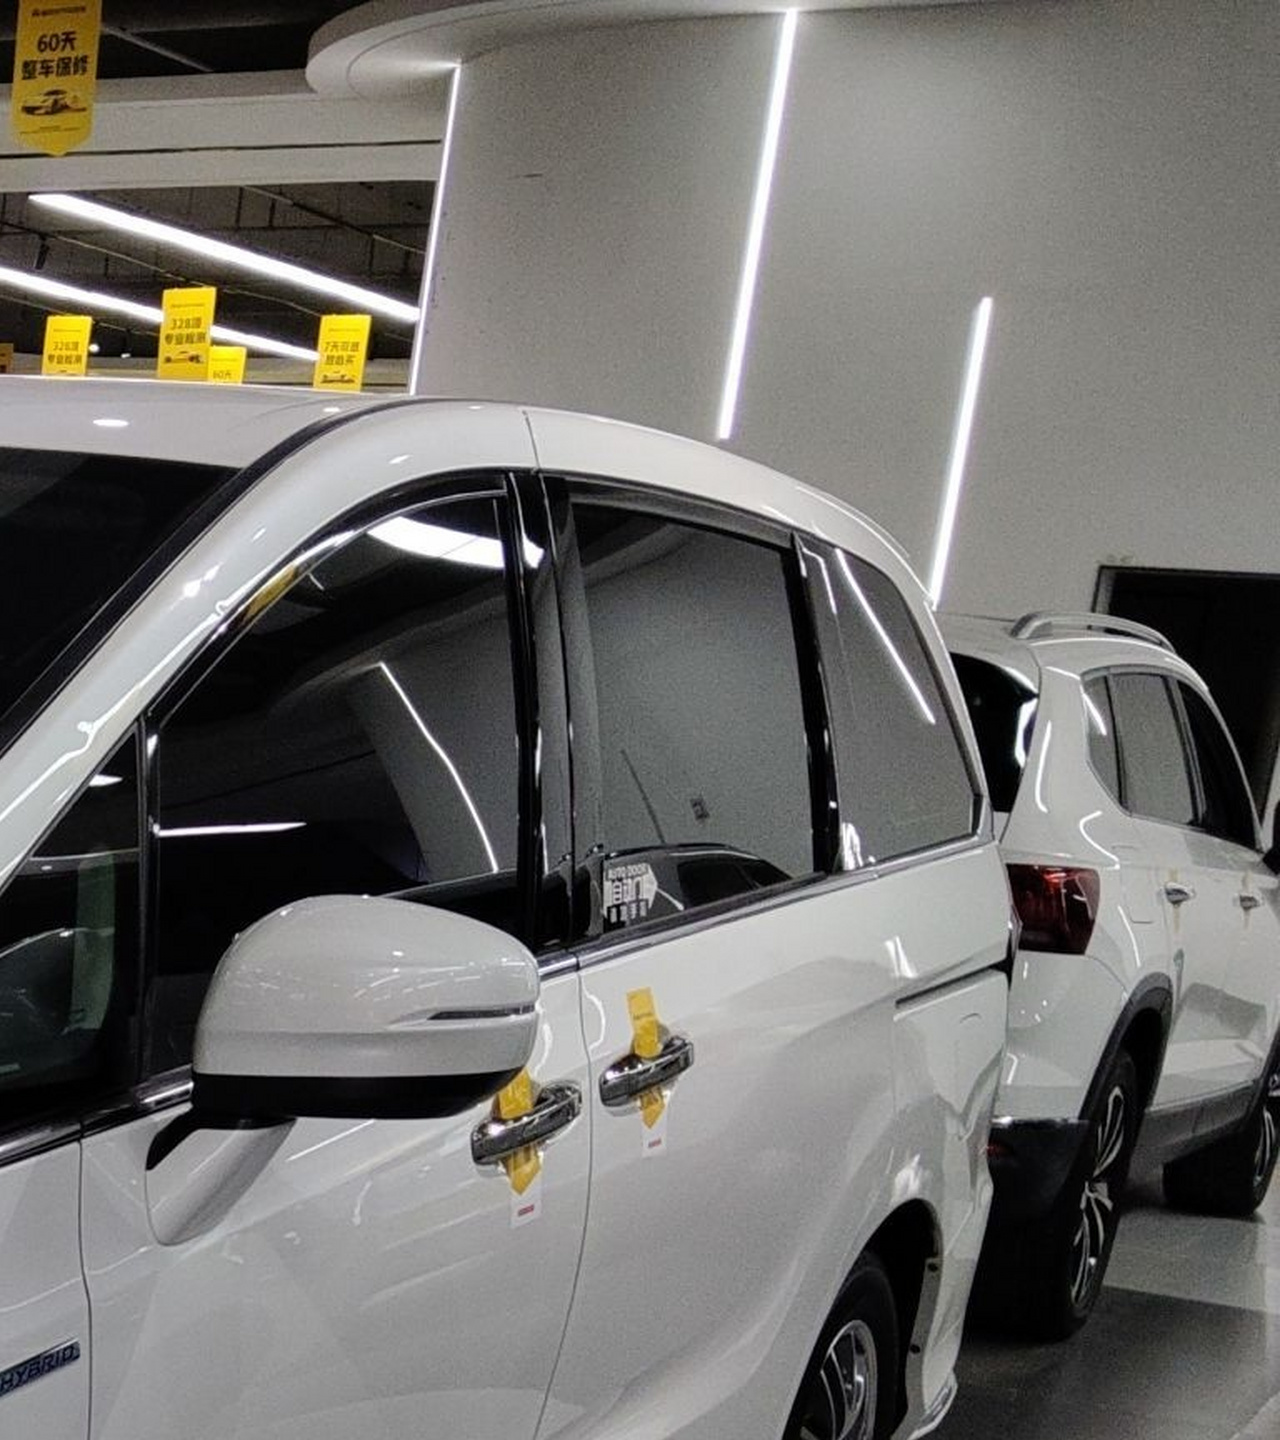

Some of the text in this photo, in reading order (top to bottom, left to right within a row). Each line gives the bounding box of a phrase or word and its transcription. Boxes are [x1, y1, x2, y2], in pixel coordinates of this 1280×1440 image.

[37, 31, 77, 52] 60天
[22, 55, 89, 80] 整车保修
[0, 1345, 75, 1395] HYBRID
